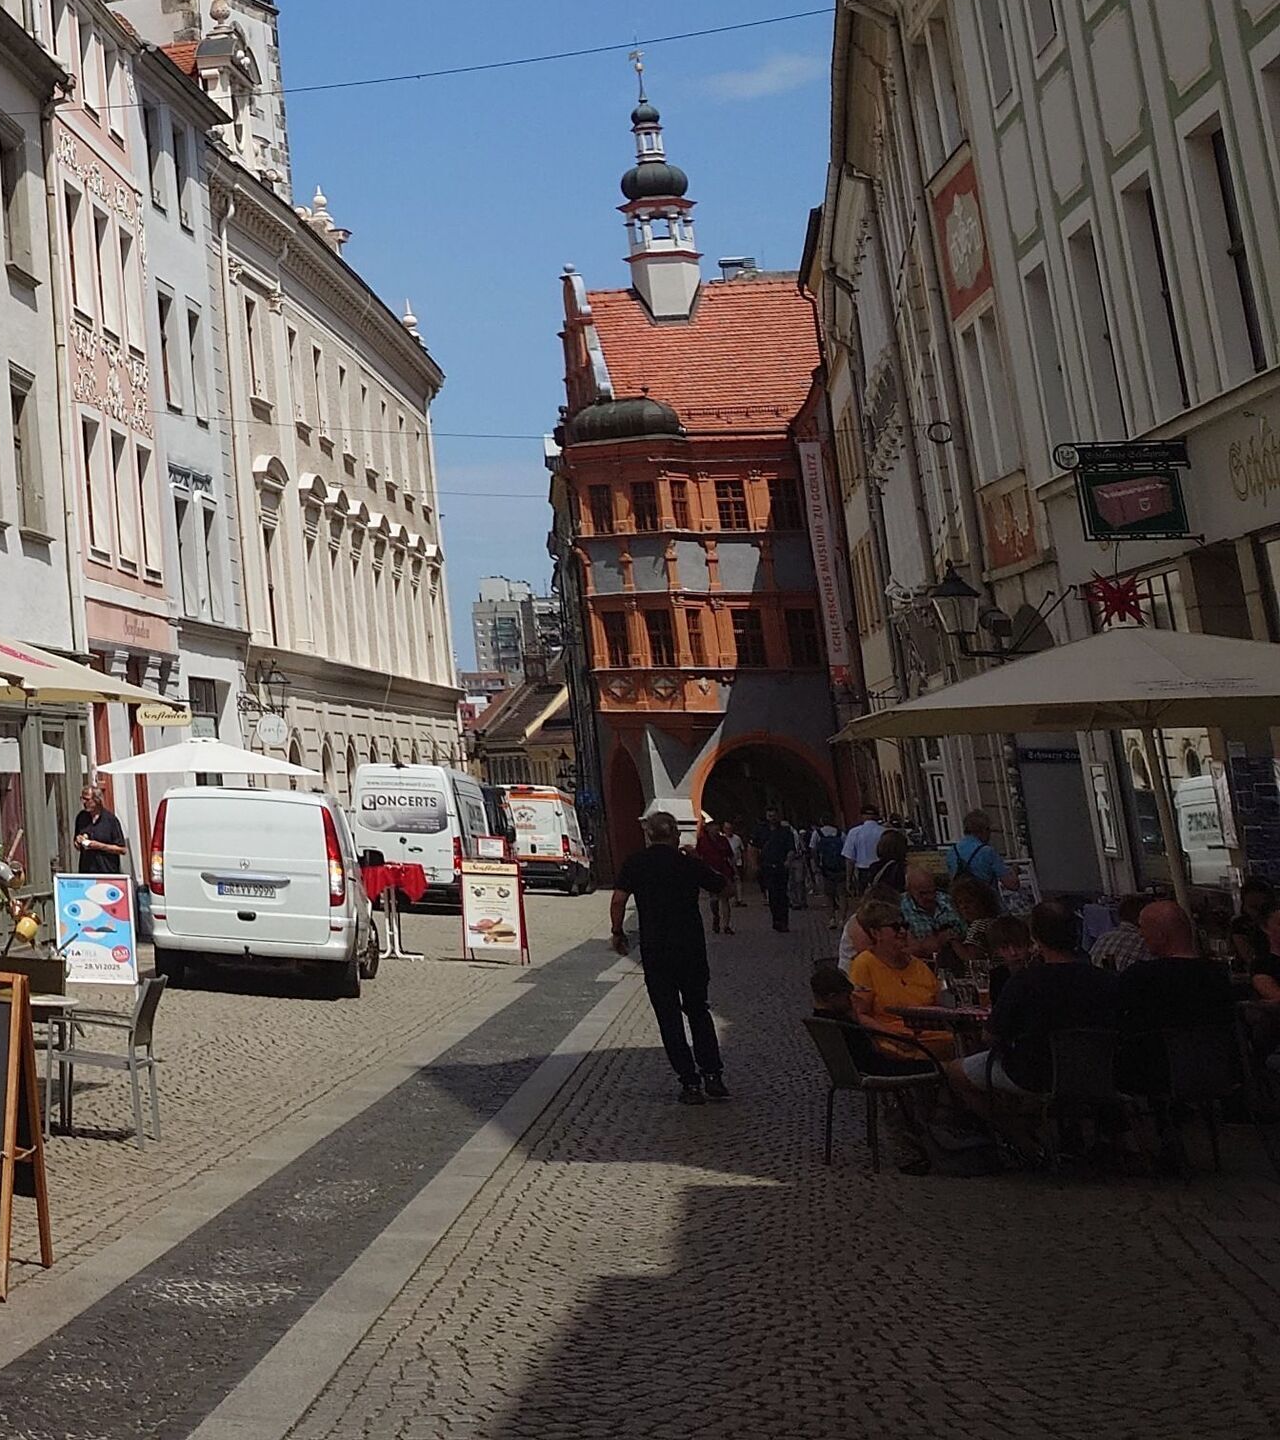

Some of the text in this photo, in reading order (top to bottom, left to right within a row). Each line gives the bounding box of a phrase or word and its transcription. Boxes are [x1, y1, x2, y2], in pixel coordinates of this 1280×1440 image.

[812, 503, 824, 521] ZU
[814, 523, 831, 573] MUSEUM
[823, 574, 842, 654] SCHLESISCHES
